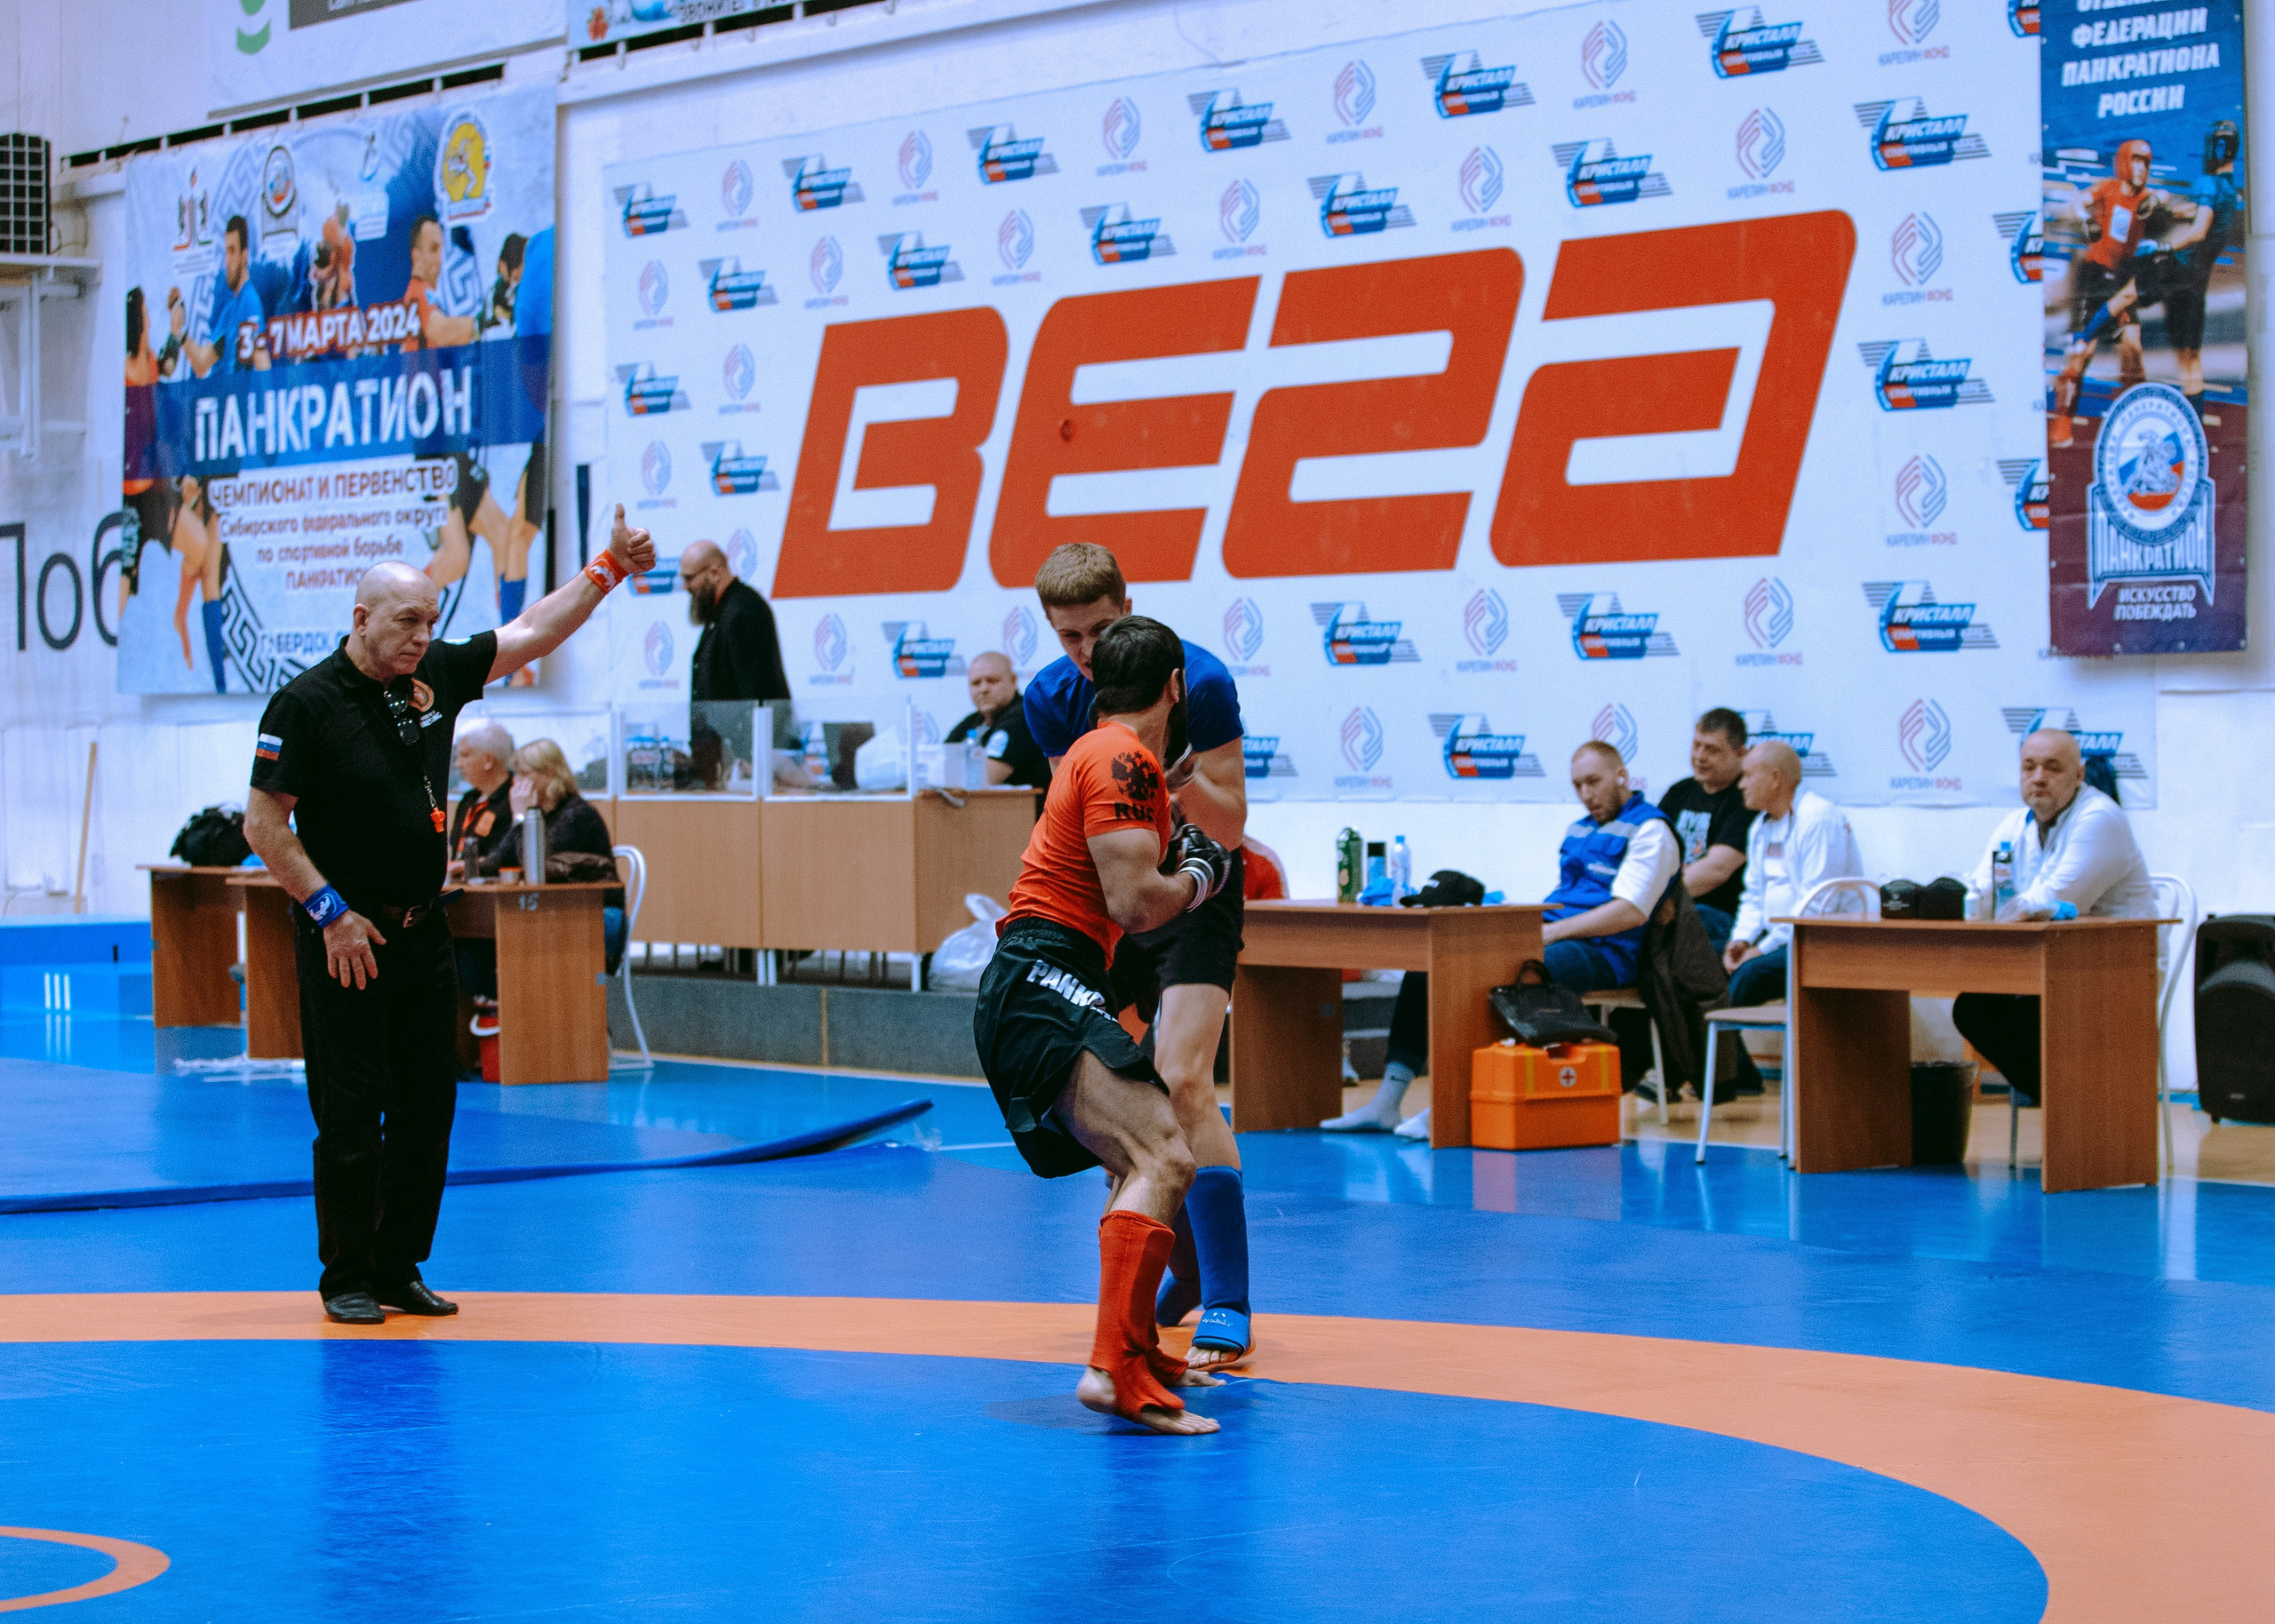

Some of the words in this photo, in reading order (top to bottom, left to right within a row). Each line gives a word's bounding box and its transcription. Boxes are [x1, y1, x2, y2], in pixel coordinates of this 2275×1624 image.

[1724, 27, 1800, 53] КРИСТАЛЛ
[2071, 7, 2207, 48] ФЕДЕРАЦИИ
[2061, 43, 2221, 87] ПАНКРАТИОНА
[1445, 68, 1513, 92] КРИСТАЛЛ
[2097, 84, 2185, 118] РОССИИ
[1883, 115, 1965, 143] КРИСТАЛЛ
[1577, 155, 1649, 181] КРИСТАЛЛ
[287, 310, 363, 353] МАРТА
[367, 303, 420, 345] 2024
[1886, 361, 1969, 385] КРИСТАЛЛ
[195, 366, 472, 462] ПАНКРАТИОН
[211, 477, 313, 507] ЧЕМПИОНАТ
[318, 475, 330, 498] И
[334, 462, 457, 498] ПЕРВЕНСТВО
[220, 514, 298, 537] Сибирского
[2094, 496, 2208, 576] ПАНКРАТИОН
[258, 547, 273, 563] по
[278, 538, 349, 562] спортивной
[354, 535, 403, 561] борьбе
[286, 568, 360, 589] ПАНКРАТИО
[2118, 585, 2197, 604] ИСКУССТВО
[1890, 606, 1974, 625] КРИСТАЛЛ
[2113, 602, 2198, 621] ПОБЕЖДАТЬ
[1584, 615, 1656, 635] КРИСТАЛЛ
[1456, 736, 1523, 755] КРИСТАЛЛ
[2074, 733, 2120, 750] ТАЛЛ
[1114, 803, 1153, 822] RUS
